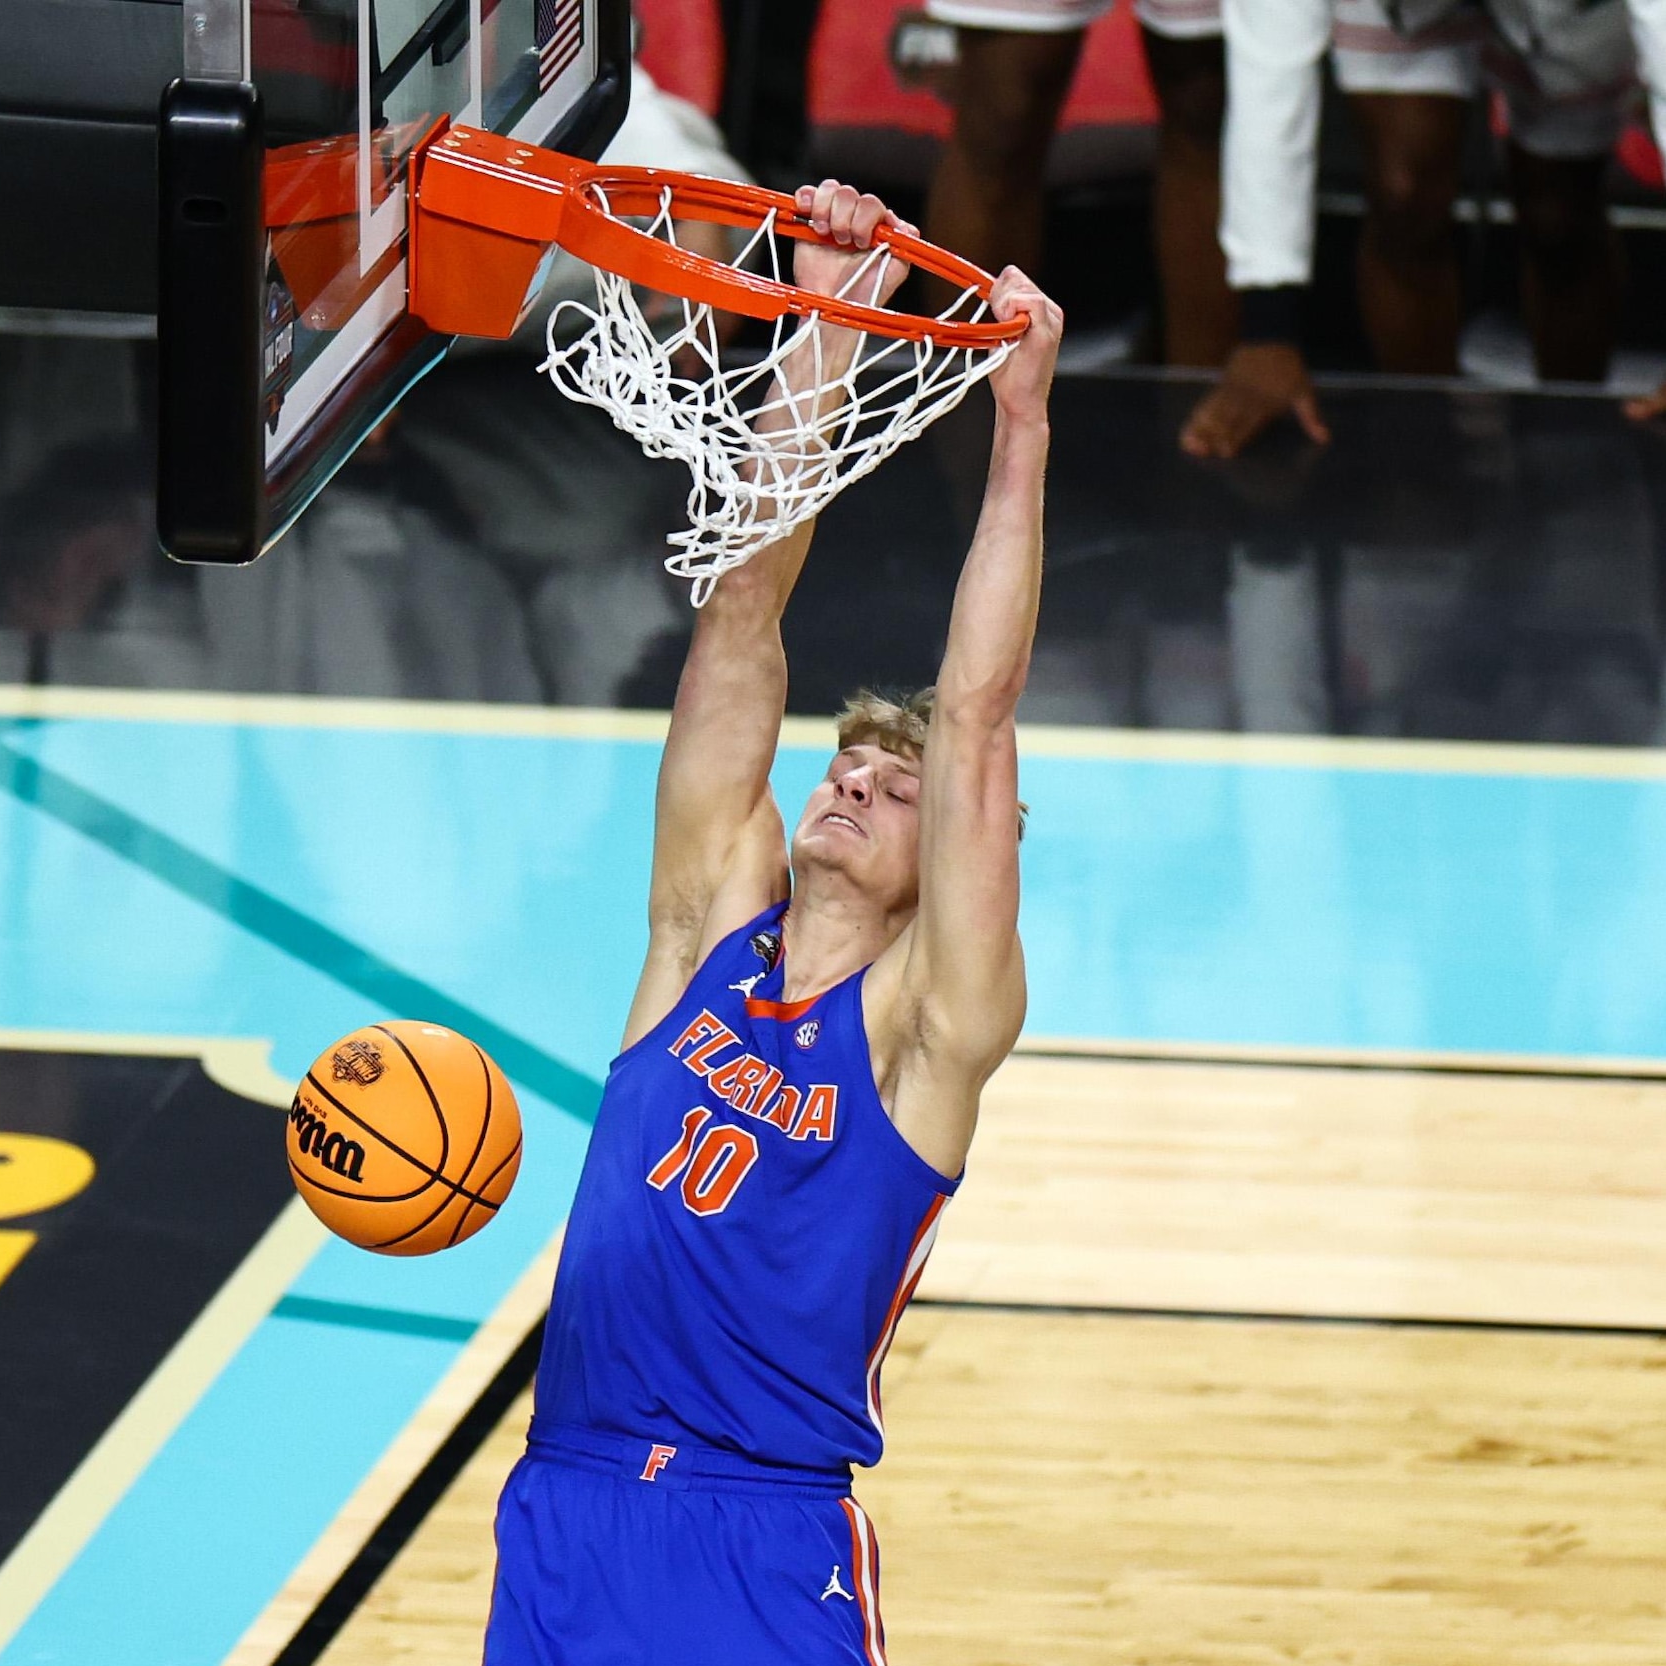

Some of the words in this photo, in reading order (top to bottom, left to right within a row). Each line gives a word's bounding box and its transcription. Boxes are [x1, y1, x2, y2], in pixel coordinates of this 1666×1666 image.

[796, 1021, 819, 1046] SEC
[667, 1008, 838, 1142] FLORIDA
[646, 1105, 759, 1218] 10
[639, 1443, 677, 1482] F
